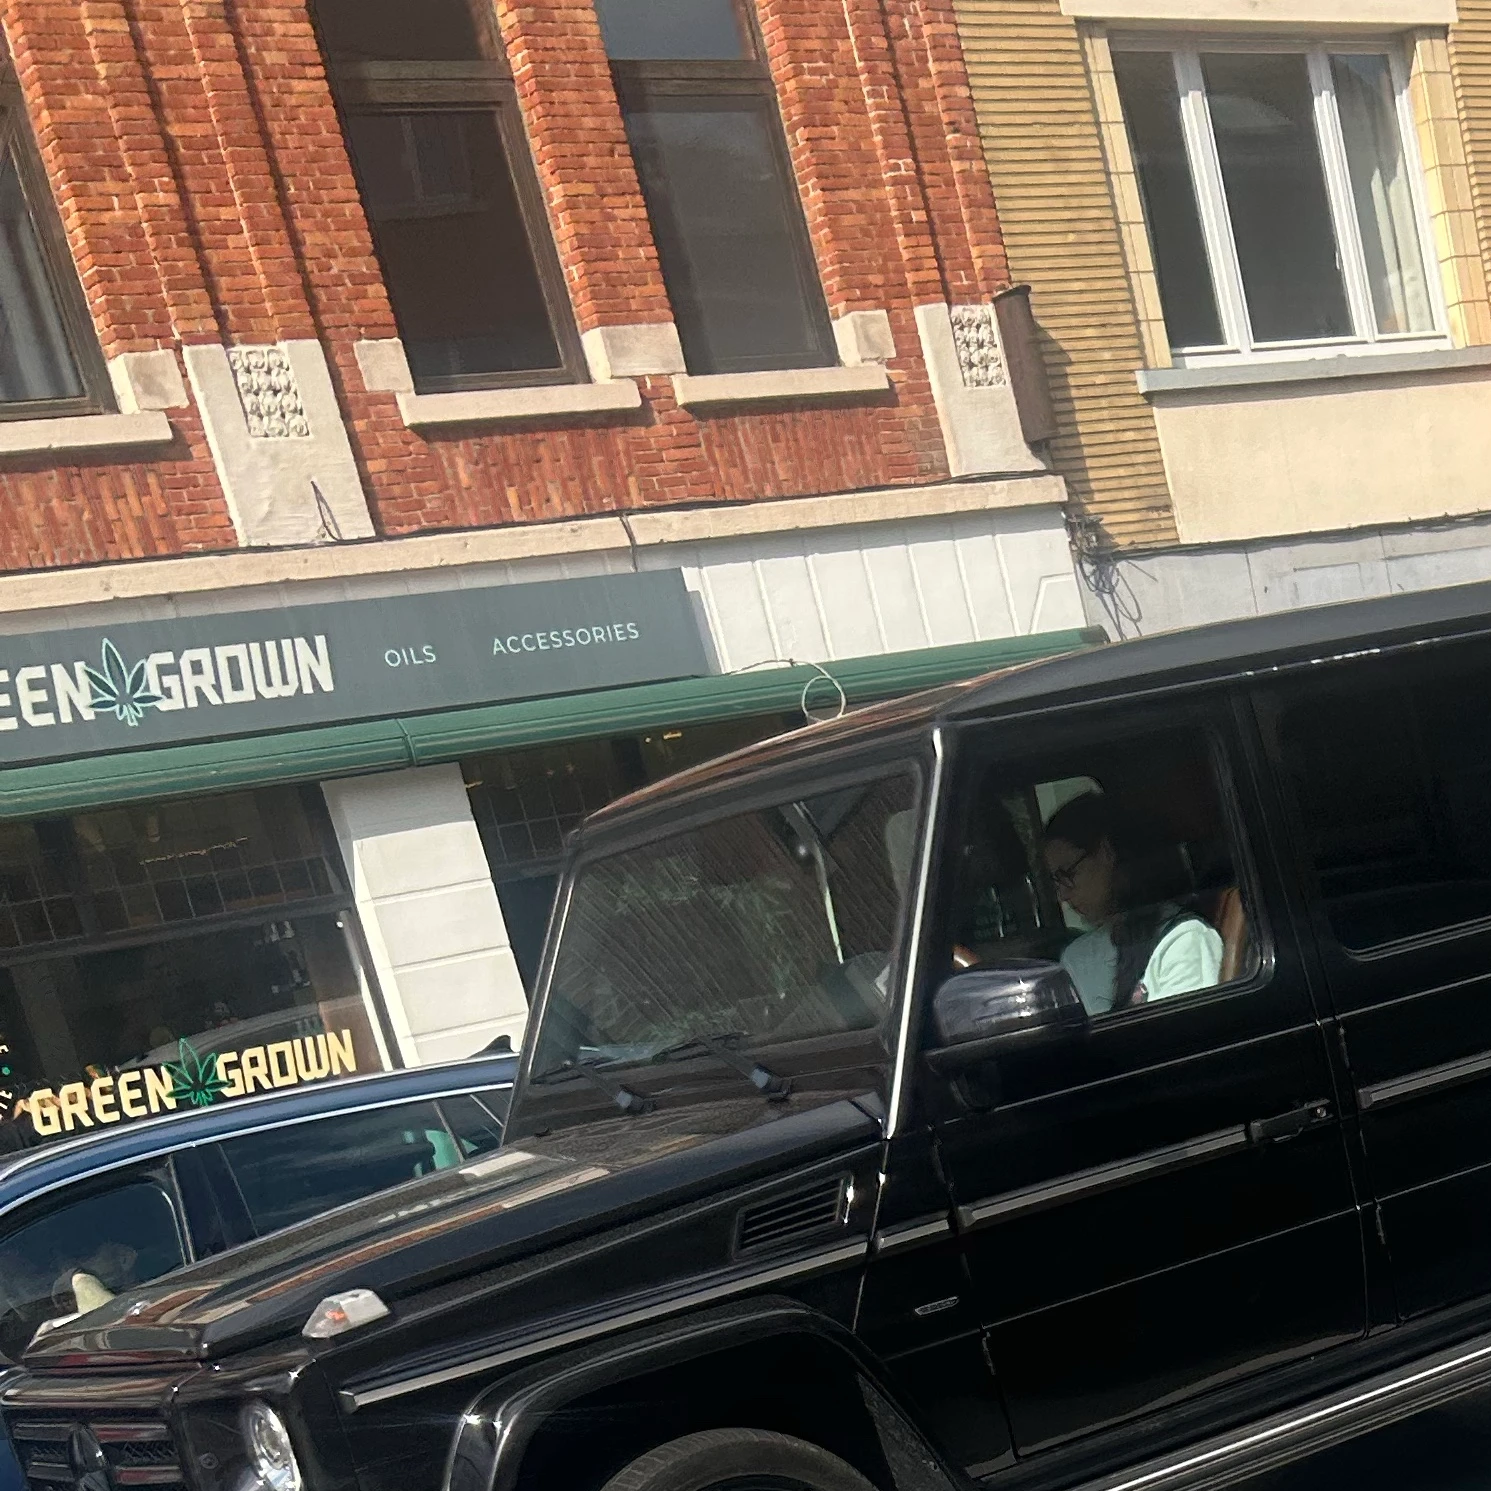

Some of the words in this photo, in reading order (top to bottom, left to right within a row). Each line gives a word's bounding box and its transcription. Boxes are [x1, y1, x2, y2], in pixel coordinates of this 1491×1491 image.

[146, 634, 335, 712] GROWN
[384, 645, 437, 667] OILS
[492, 622, 640, 656] ACCESSORIES
[29, 1067, 177, 1136] GREEN
[215, 1028, 358, 1099] GROWN
